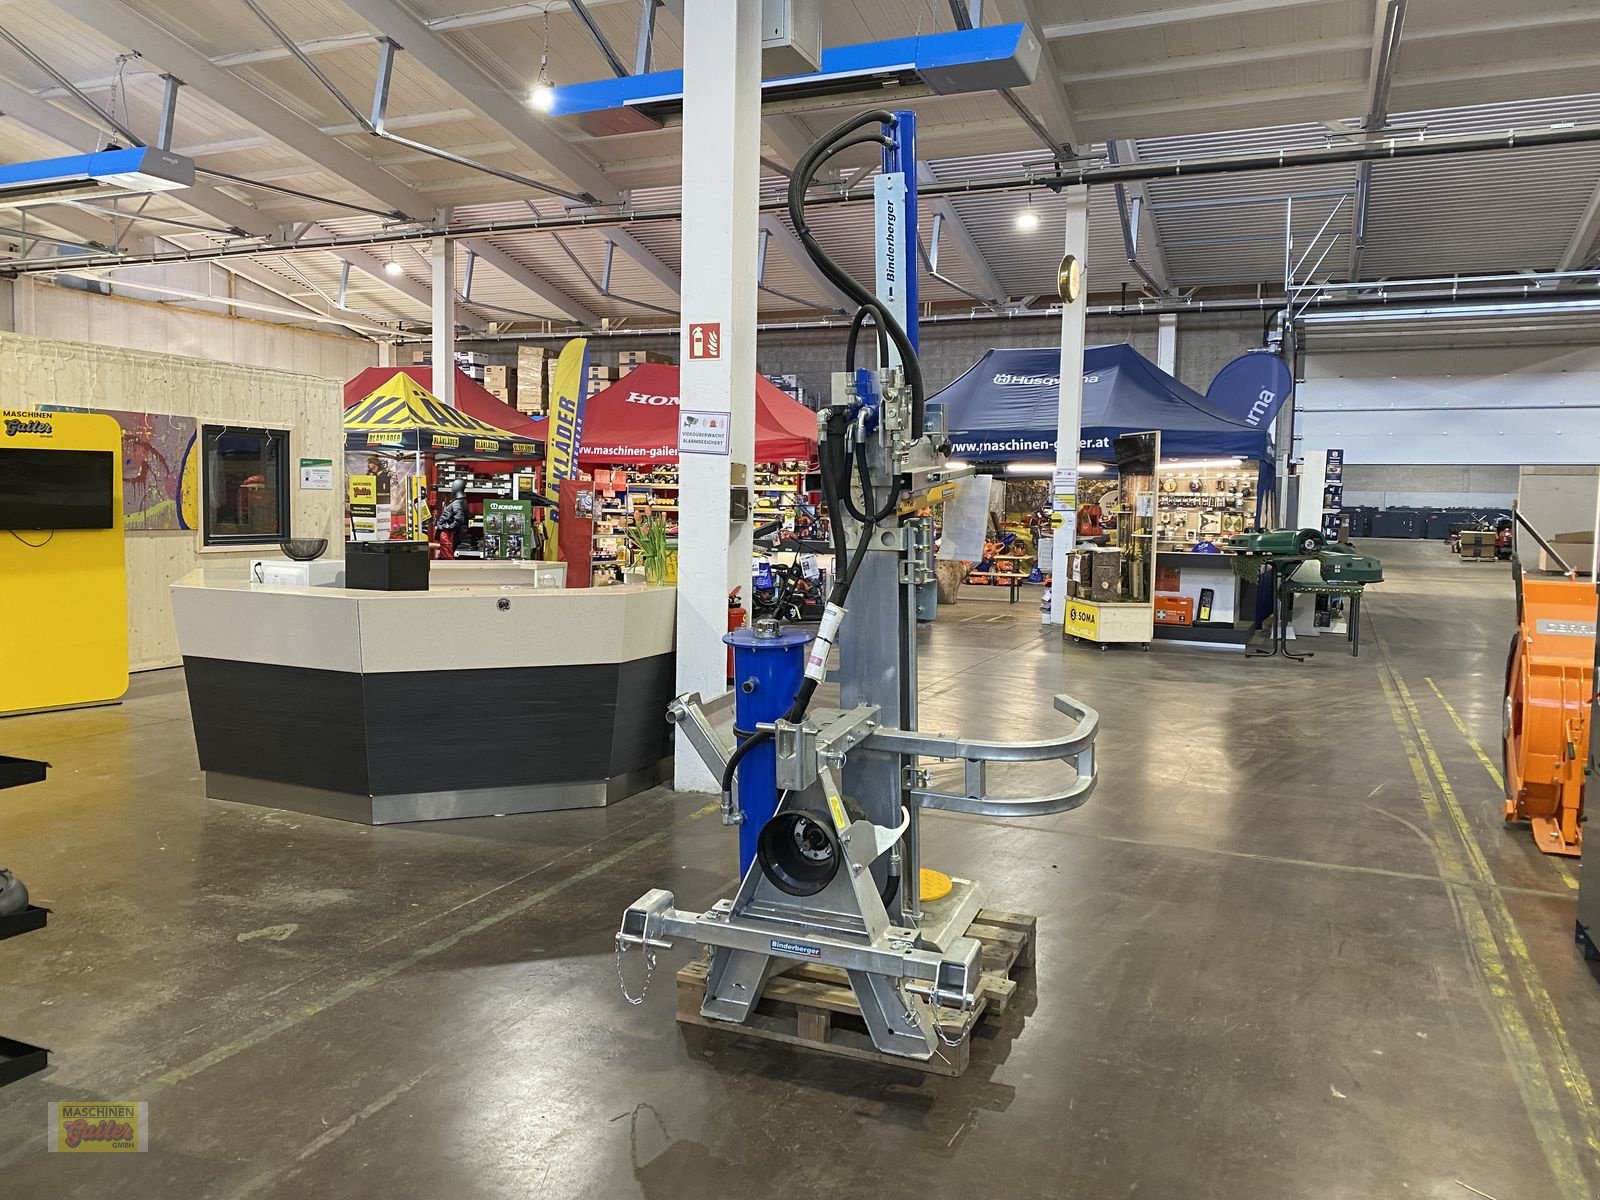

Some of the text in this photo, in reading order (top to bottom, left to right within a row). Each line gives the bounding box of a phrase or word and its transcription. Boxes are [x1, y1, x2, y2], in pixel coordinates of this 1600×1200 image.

[886, 199, 896, 282] Binderberger
[4, 419, 52, 436] Gailer
[1078, 611, 1095, 625] SOMA
[771, 940, 820, 955] Binderberger
